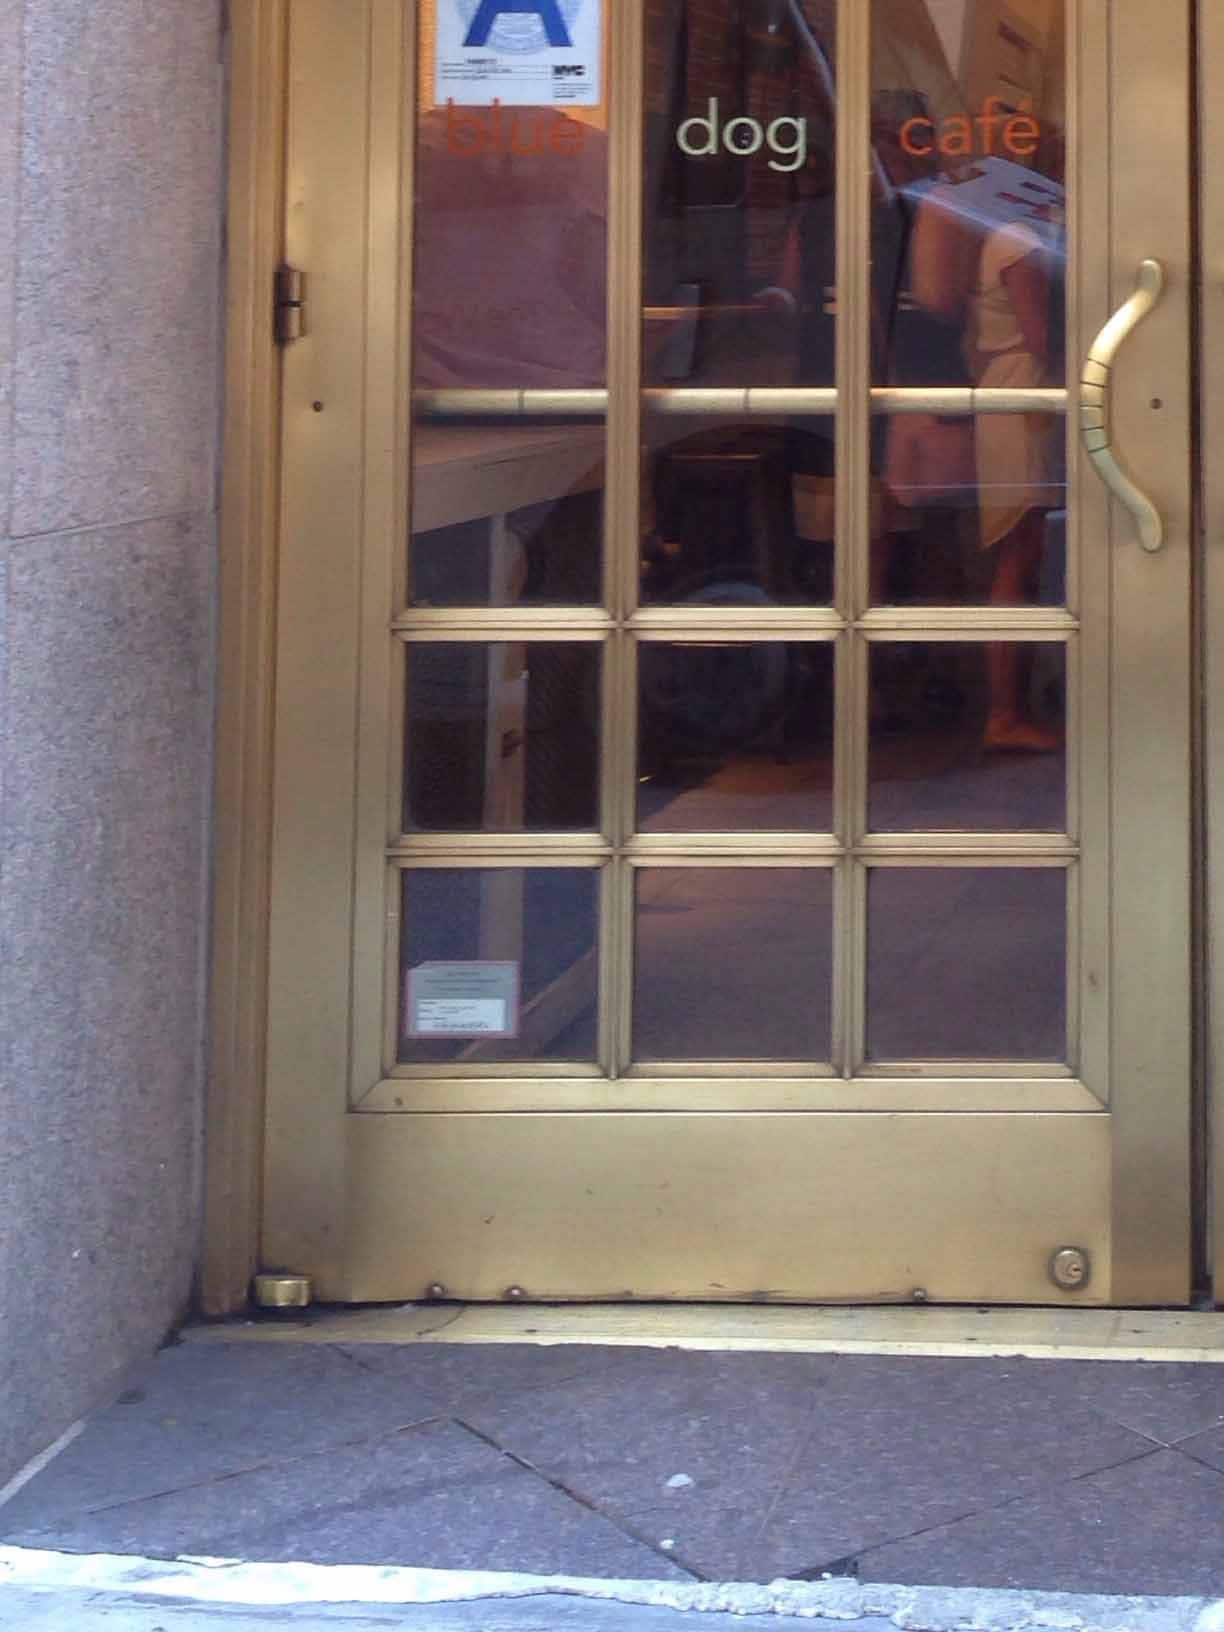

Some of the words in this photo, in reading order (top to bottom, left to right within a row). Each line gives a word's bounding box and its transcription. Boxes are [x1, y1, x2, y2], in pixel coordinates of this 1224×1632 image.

[446, 95, 584, 156] blue
[677, 97, 808, 172] dog
[901, 95, 1042, 156] café
